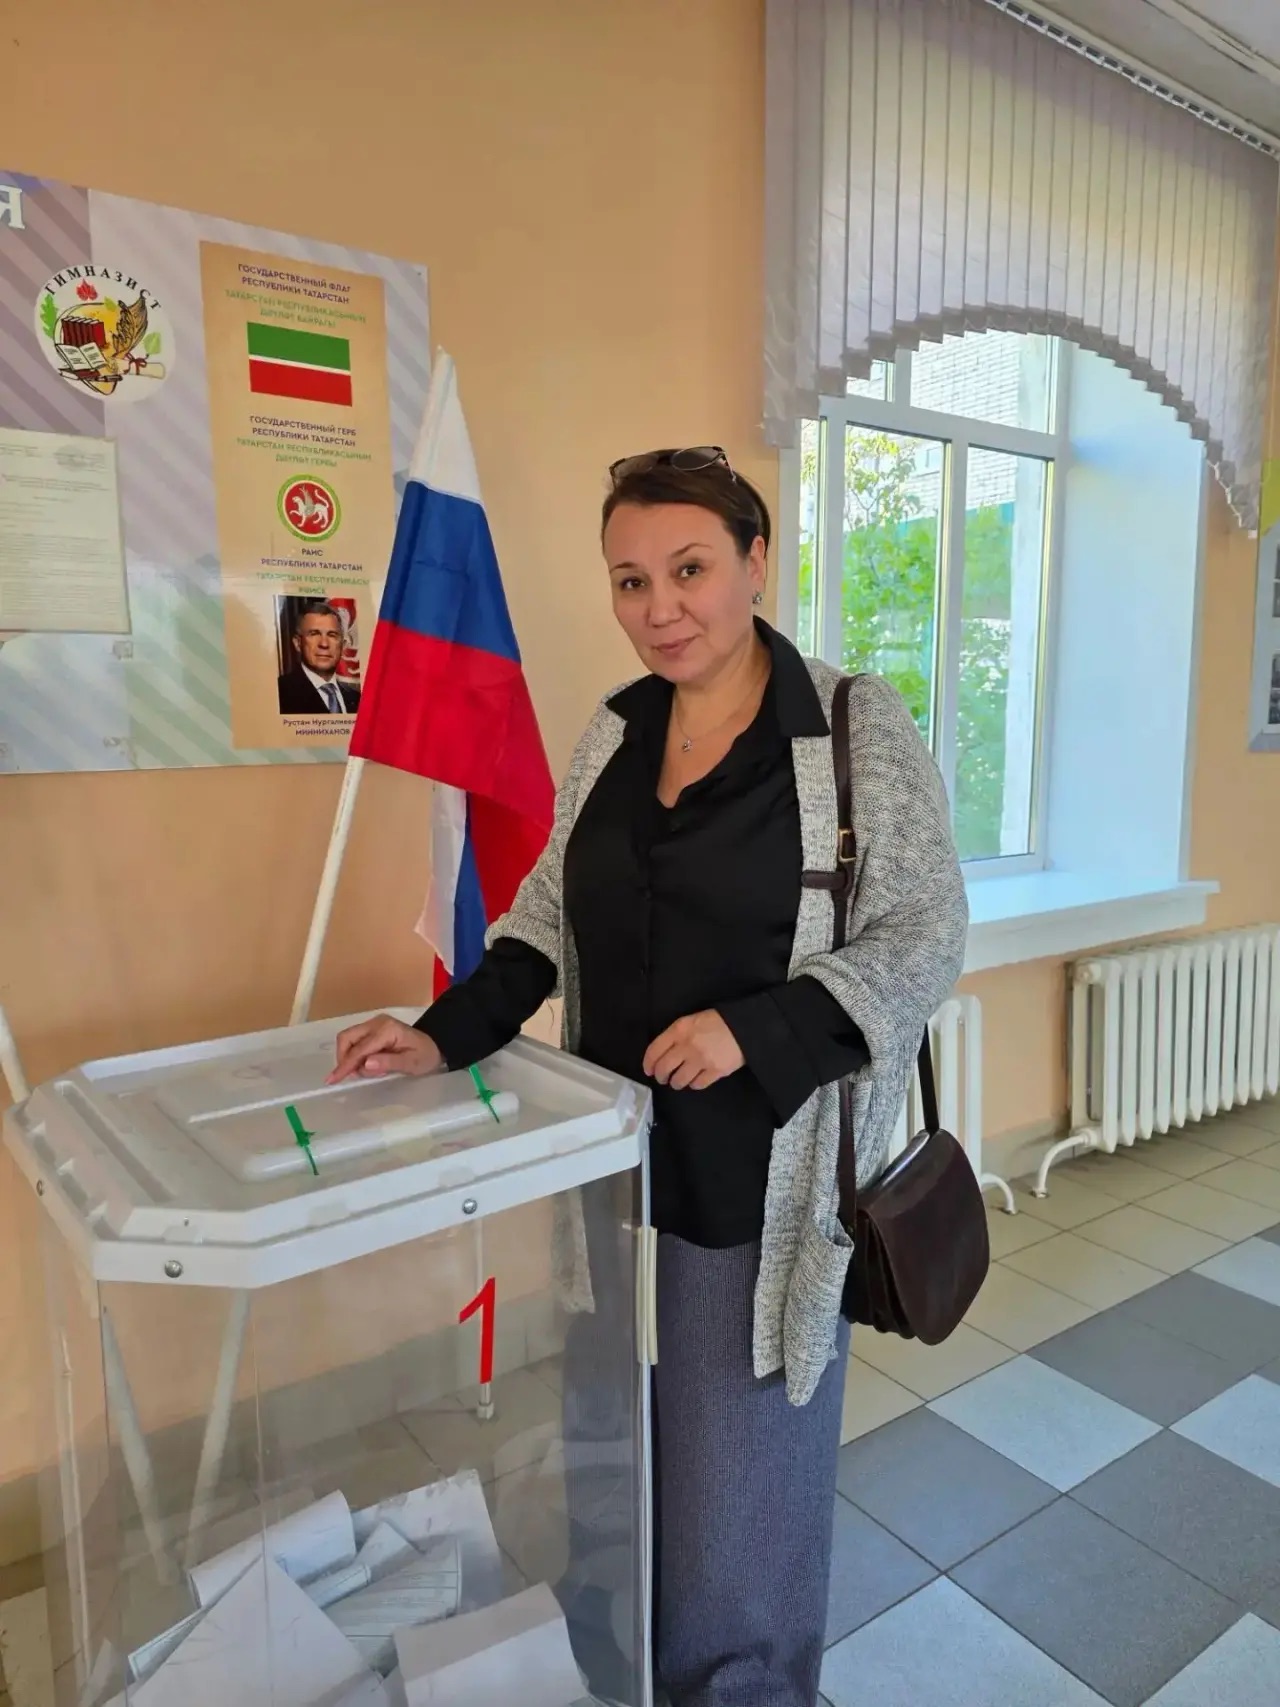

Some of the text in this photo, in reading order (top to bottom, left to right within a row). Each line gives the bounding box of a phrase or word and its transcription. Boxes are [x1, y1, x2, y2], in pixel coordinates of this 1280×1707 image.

[44, 265, 161, 310] ГИМНАЗИСТ
[238, 263, 351, 293] ГОСУДАРСТВЕННЫЙ ФЛАГ
[241, 276, 349, 304] РЕСПУБЛИКИ ТАТАРСТАН
[249, 415, 356, 437] ГОСУДАРСТВЕННЫЙ ГЕРБ
[236, 437, 285, 450] ТАТАРСТАН
[252, 427, 356, 447] РЕСПУБЛИКИ ТАТАРСТАН
[301, 548, 324, 557] РАИС
[261, 558, 363, 572] РЕСПУБЛИКИ ТАТАРСТАН
[283, 719, 311, 727] Рустам
[295, 728, 351, 736] МИННИХАНОВ
[458, 1275, 496, 1385] 1
